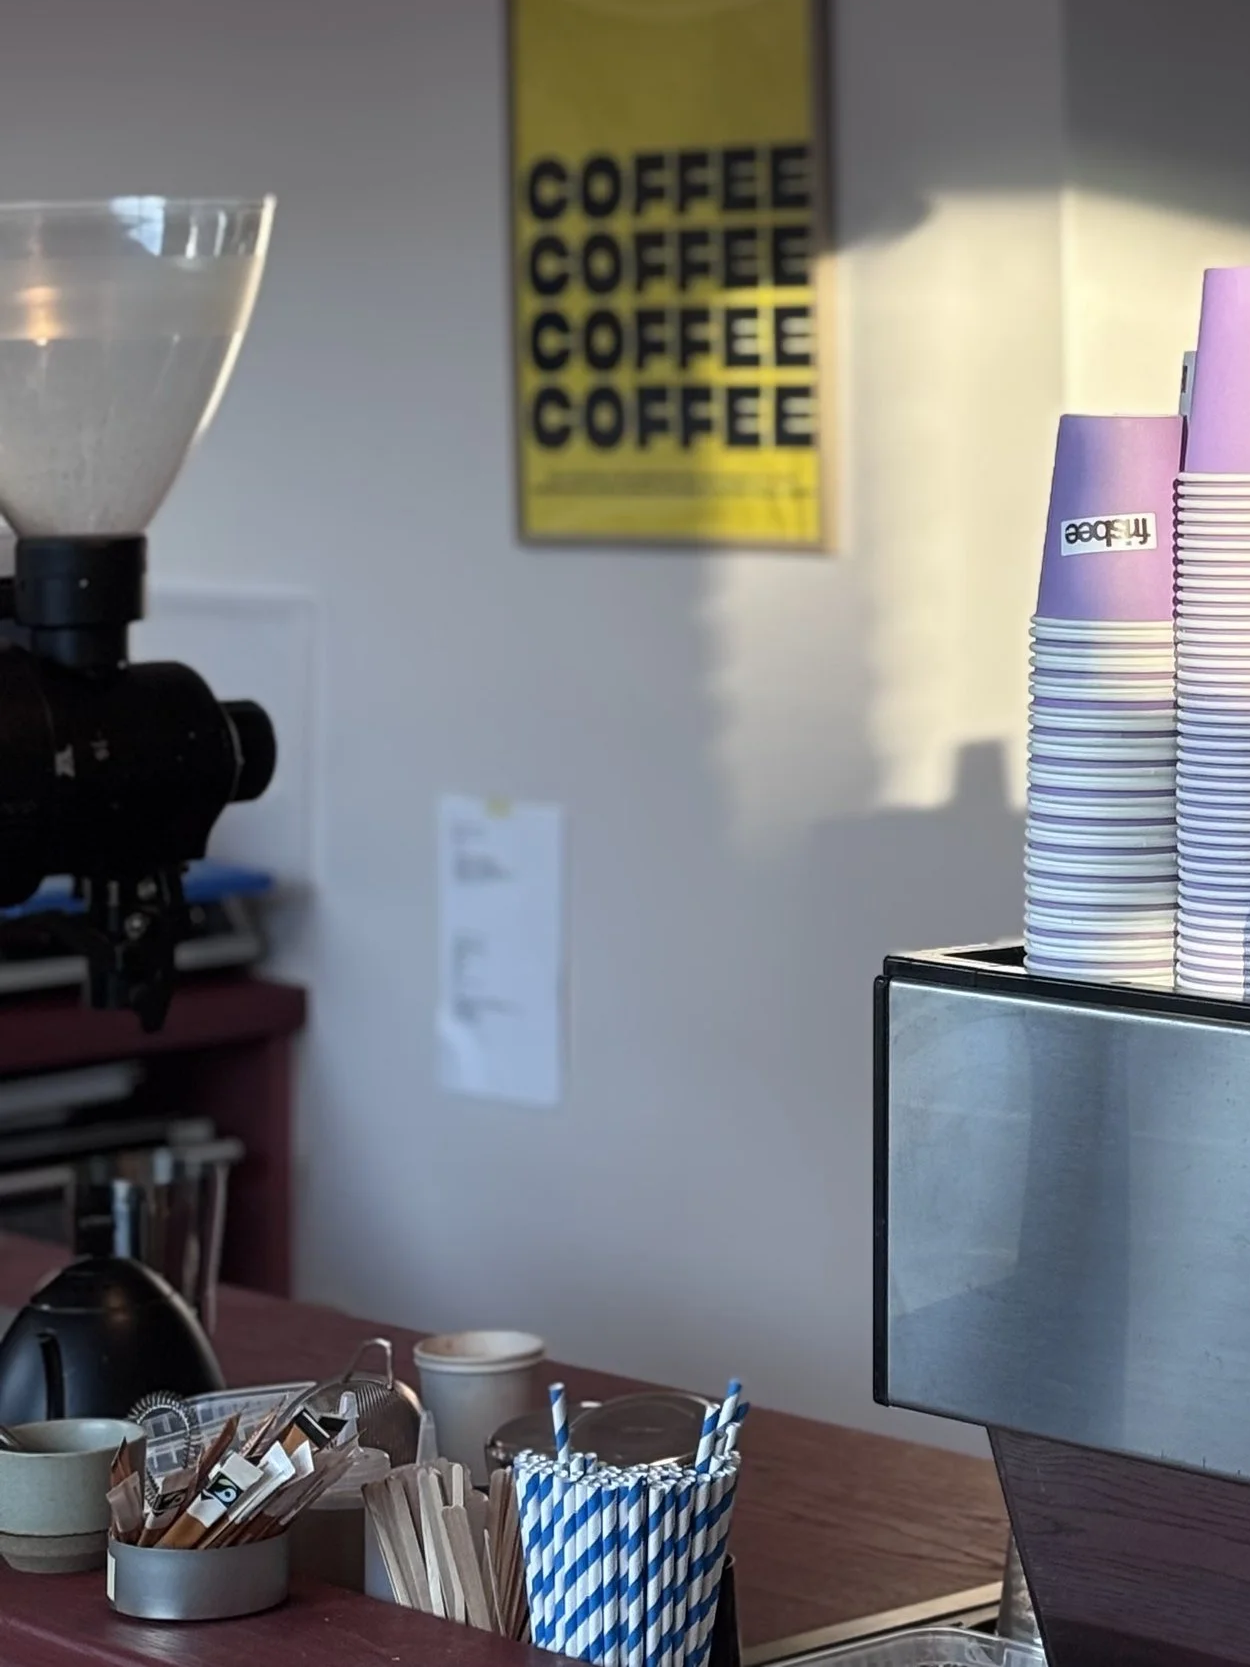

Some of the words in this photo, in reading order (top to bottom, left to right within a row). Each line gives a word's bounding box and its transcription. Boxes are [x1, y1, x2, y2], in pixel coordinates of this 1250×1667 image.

[529, 146, 813, 220] COFFEE
[530, 224, 814, 295] COFFEE
[532, 306, 815, 372] COFFEE
[534, 385, 817, 452] COFFEE
[1064, 517, 1151, 548] frisbee
